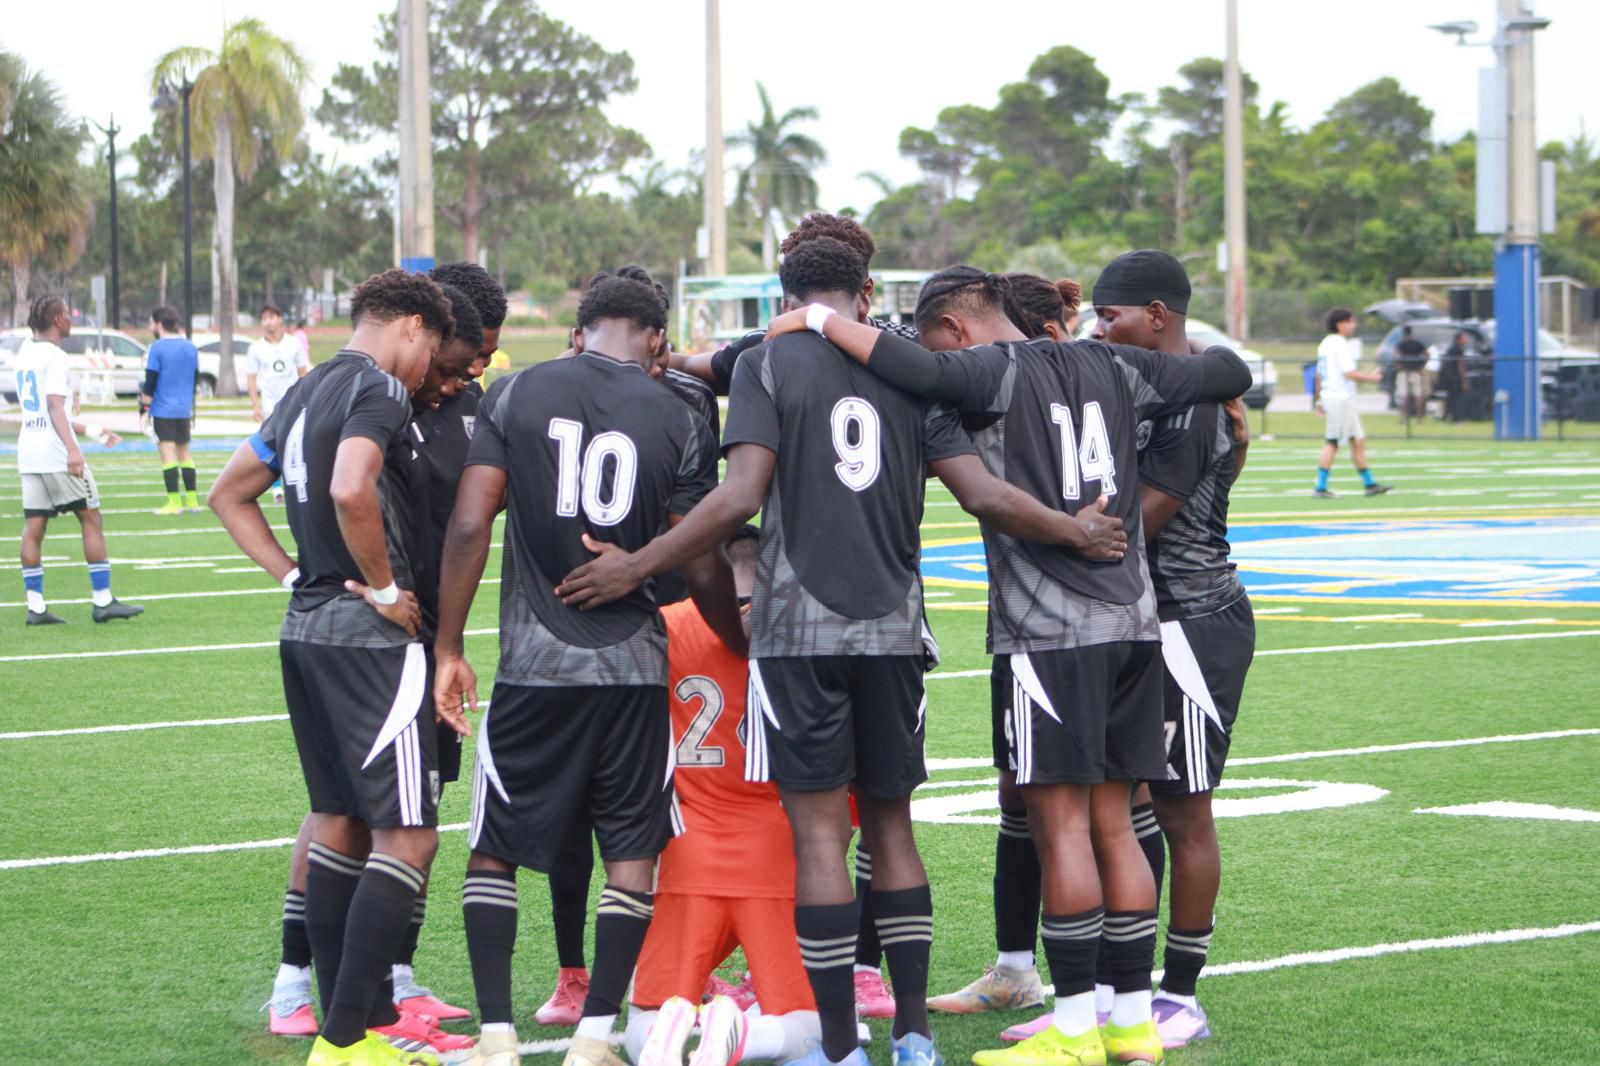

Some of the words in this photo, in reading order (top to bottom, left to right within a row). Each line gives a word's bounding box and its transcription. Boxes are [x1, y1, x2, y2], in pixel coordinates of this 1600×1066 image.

[283, 407, 308, 503] 4
[548, 417, 638, 526] 10
[831, 396, 881, 492] 9
[1050, 401, 1117, 500] 14
[674, 674, 747, 768] 2
